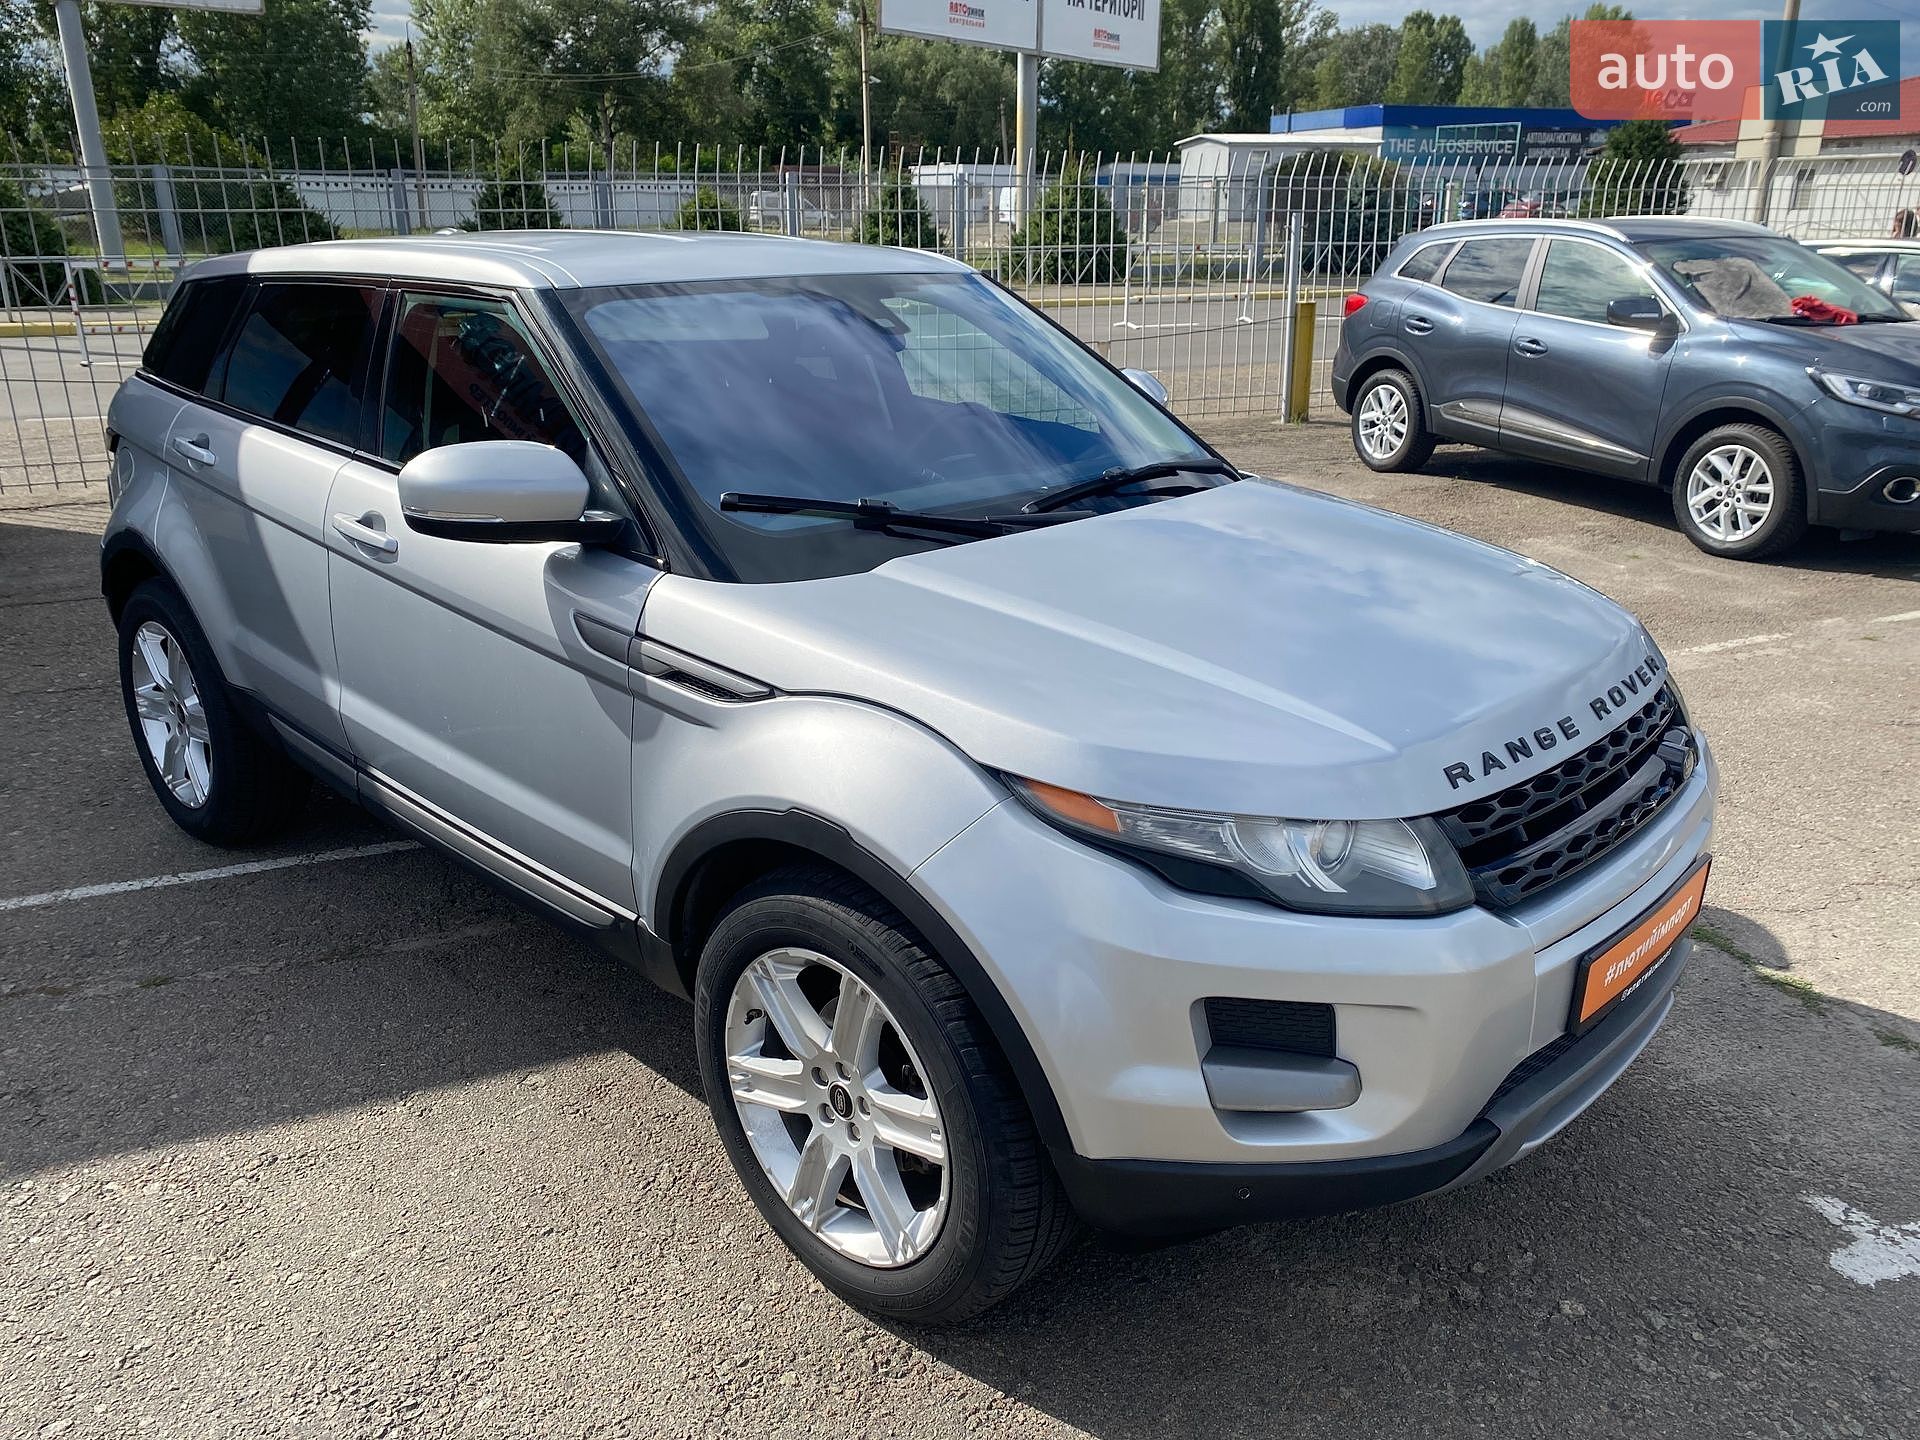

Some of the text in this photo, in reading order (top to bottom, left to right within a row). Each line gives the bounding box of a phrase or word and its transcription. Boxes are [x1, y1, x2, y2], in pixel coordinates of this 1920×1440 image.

[1388, 138, 1513, 154] THE AUTOSERVICE
[1443, 654, 1661, 790] RANGE ROVER
[1603, 895, 1694, 988] #лютийімпорт
